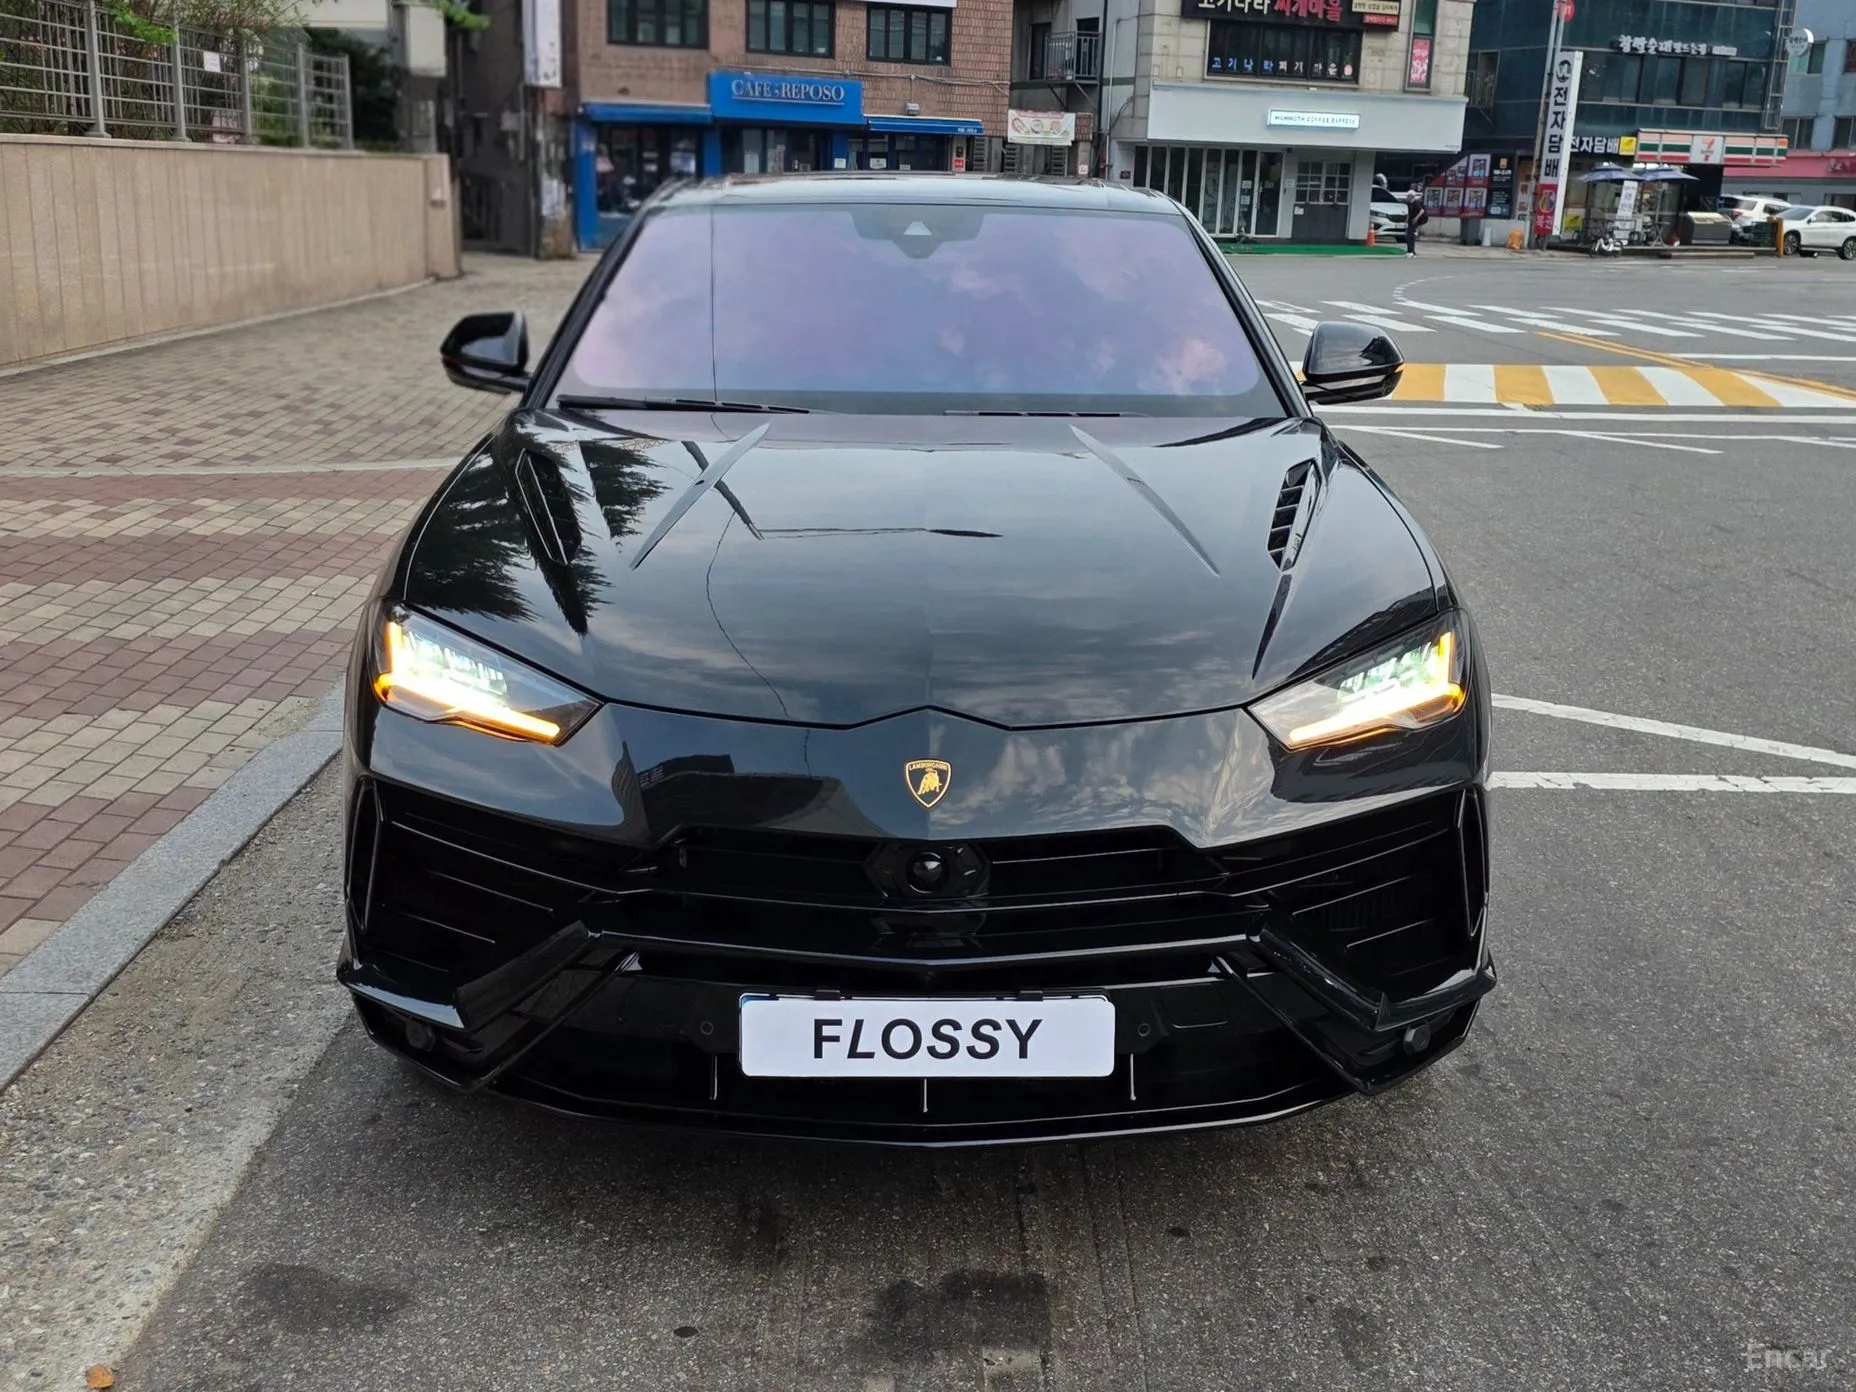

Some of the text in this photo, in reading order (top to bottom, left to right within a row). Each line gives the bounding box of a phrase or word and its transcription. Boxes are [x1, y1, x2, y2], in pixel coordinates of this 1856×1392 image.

[731, 79, 845, 101] CAFE REPOSO
[1544, 86, 1568, 178] 전자담배
[813, 1018, 1043, 1060] FLOSSY
